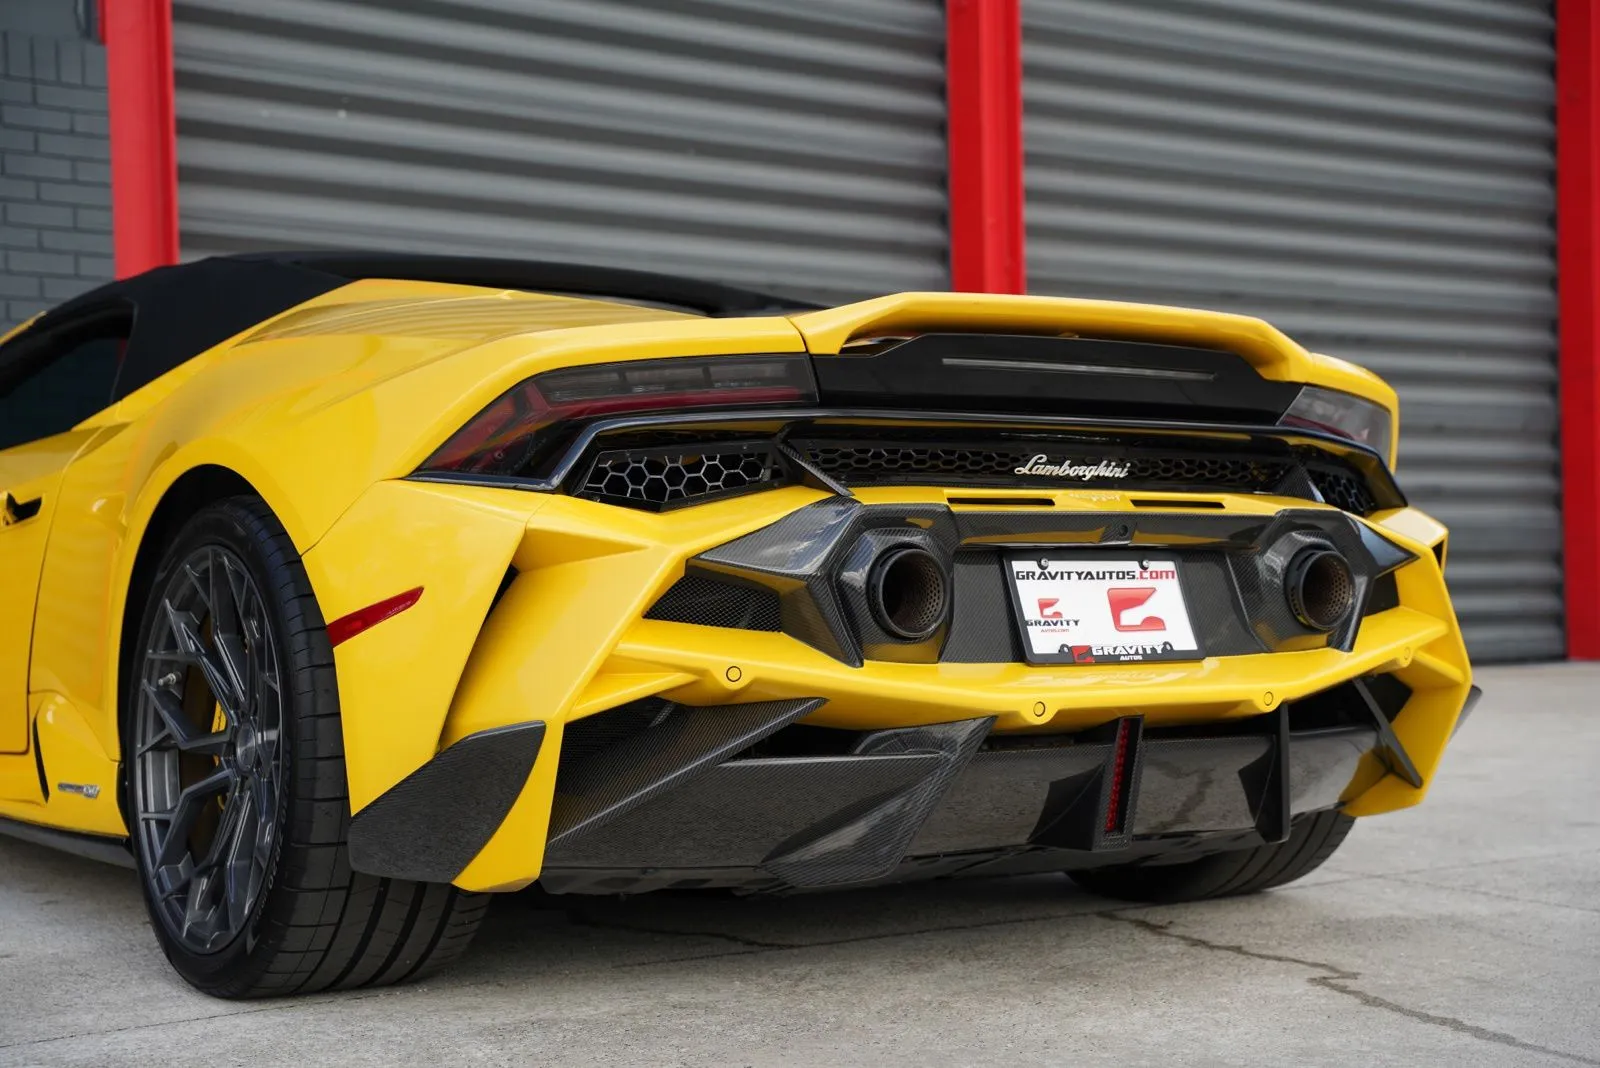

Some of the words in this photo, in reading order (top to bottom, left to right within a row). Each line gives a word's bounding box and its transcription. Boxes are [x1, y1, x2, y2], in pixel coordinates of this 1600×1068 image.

[1014, 454, 1131, 480] Lamborghini
[1025, 619, 1080, 627] GRAVITY
[1091, 644, 1165, 656] GRAVITY
